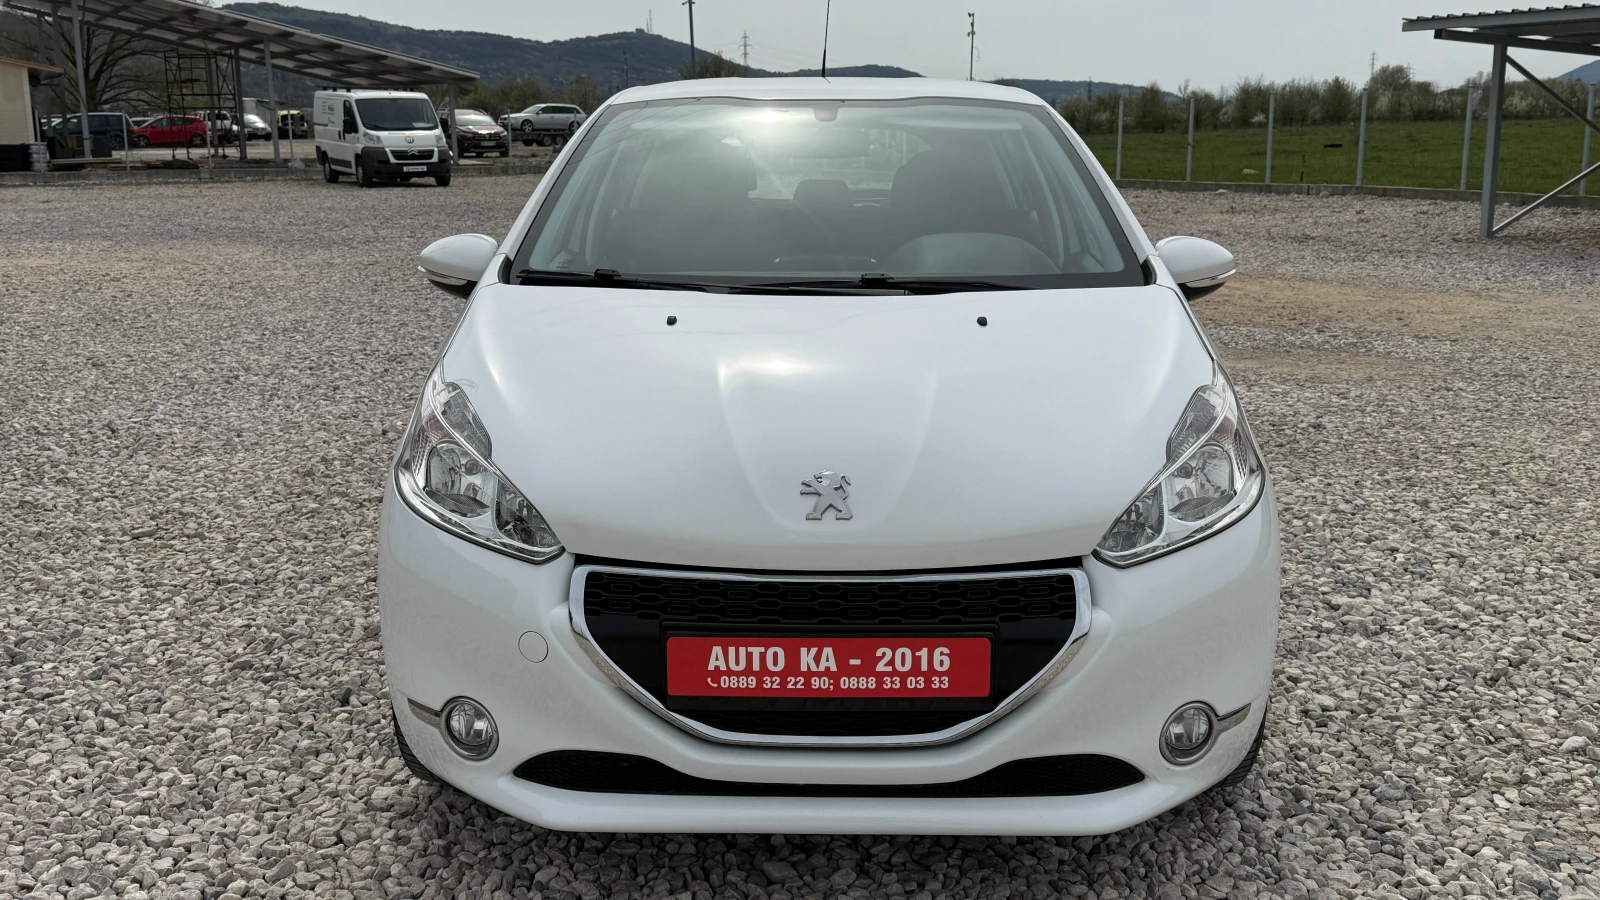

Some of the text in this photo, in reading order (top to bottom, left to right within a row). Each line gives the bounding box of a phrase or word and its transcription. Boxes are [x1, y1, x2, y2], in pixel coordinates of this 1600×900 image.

[707, 646, 786, 672] AUTO
[800, 646, 838, 672] KA
[875, 647, 951, 672] 2016
[720, 675, 949, 691] 0889 32 22 90; 0888 33 03 33
